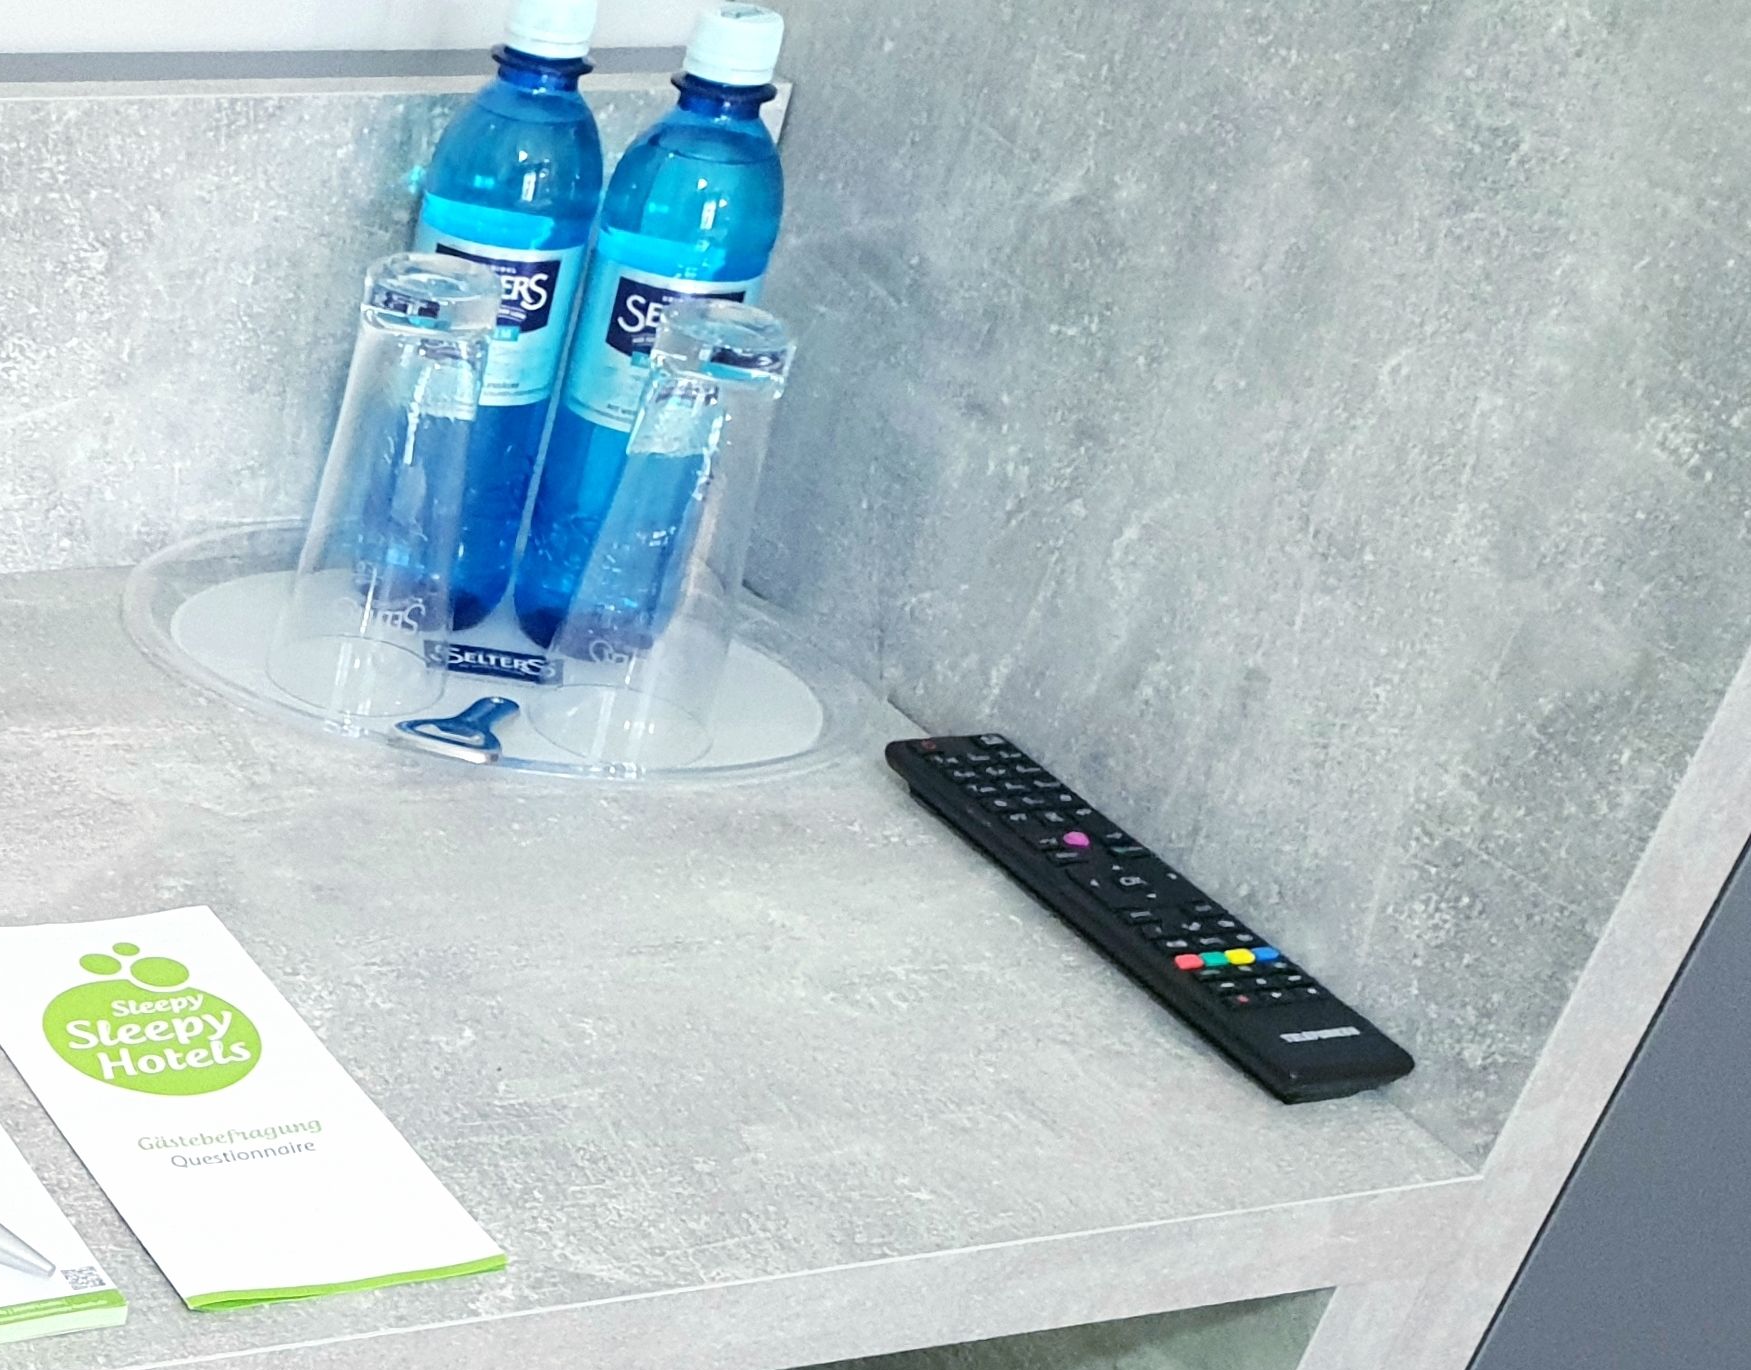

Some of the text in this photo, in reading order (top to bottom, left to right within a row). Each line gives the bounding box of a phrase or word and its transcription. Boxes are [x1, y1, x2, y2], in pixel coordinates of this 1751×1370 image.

[448, 647, 548, 678] SELTERS
[111, 994, 204, 1017] Sleepy
[66, 1010, 233, 1049] Sleepy
[97, 1040, 252, 1080] Hotels
[138, 1120, 322, 1150] Gästebefragung
[171, 1142, 316, 1168] Questionnaire
